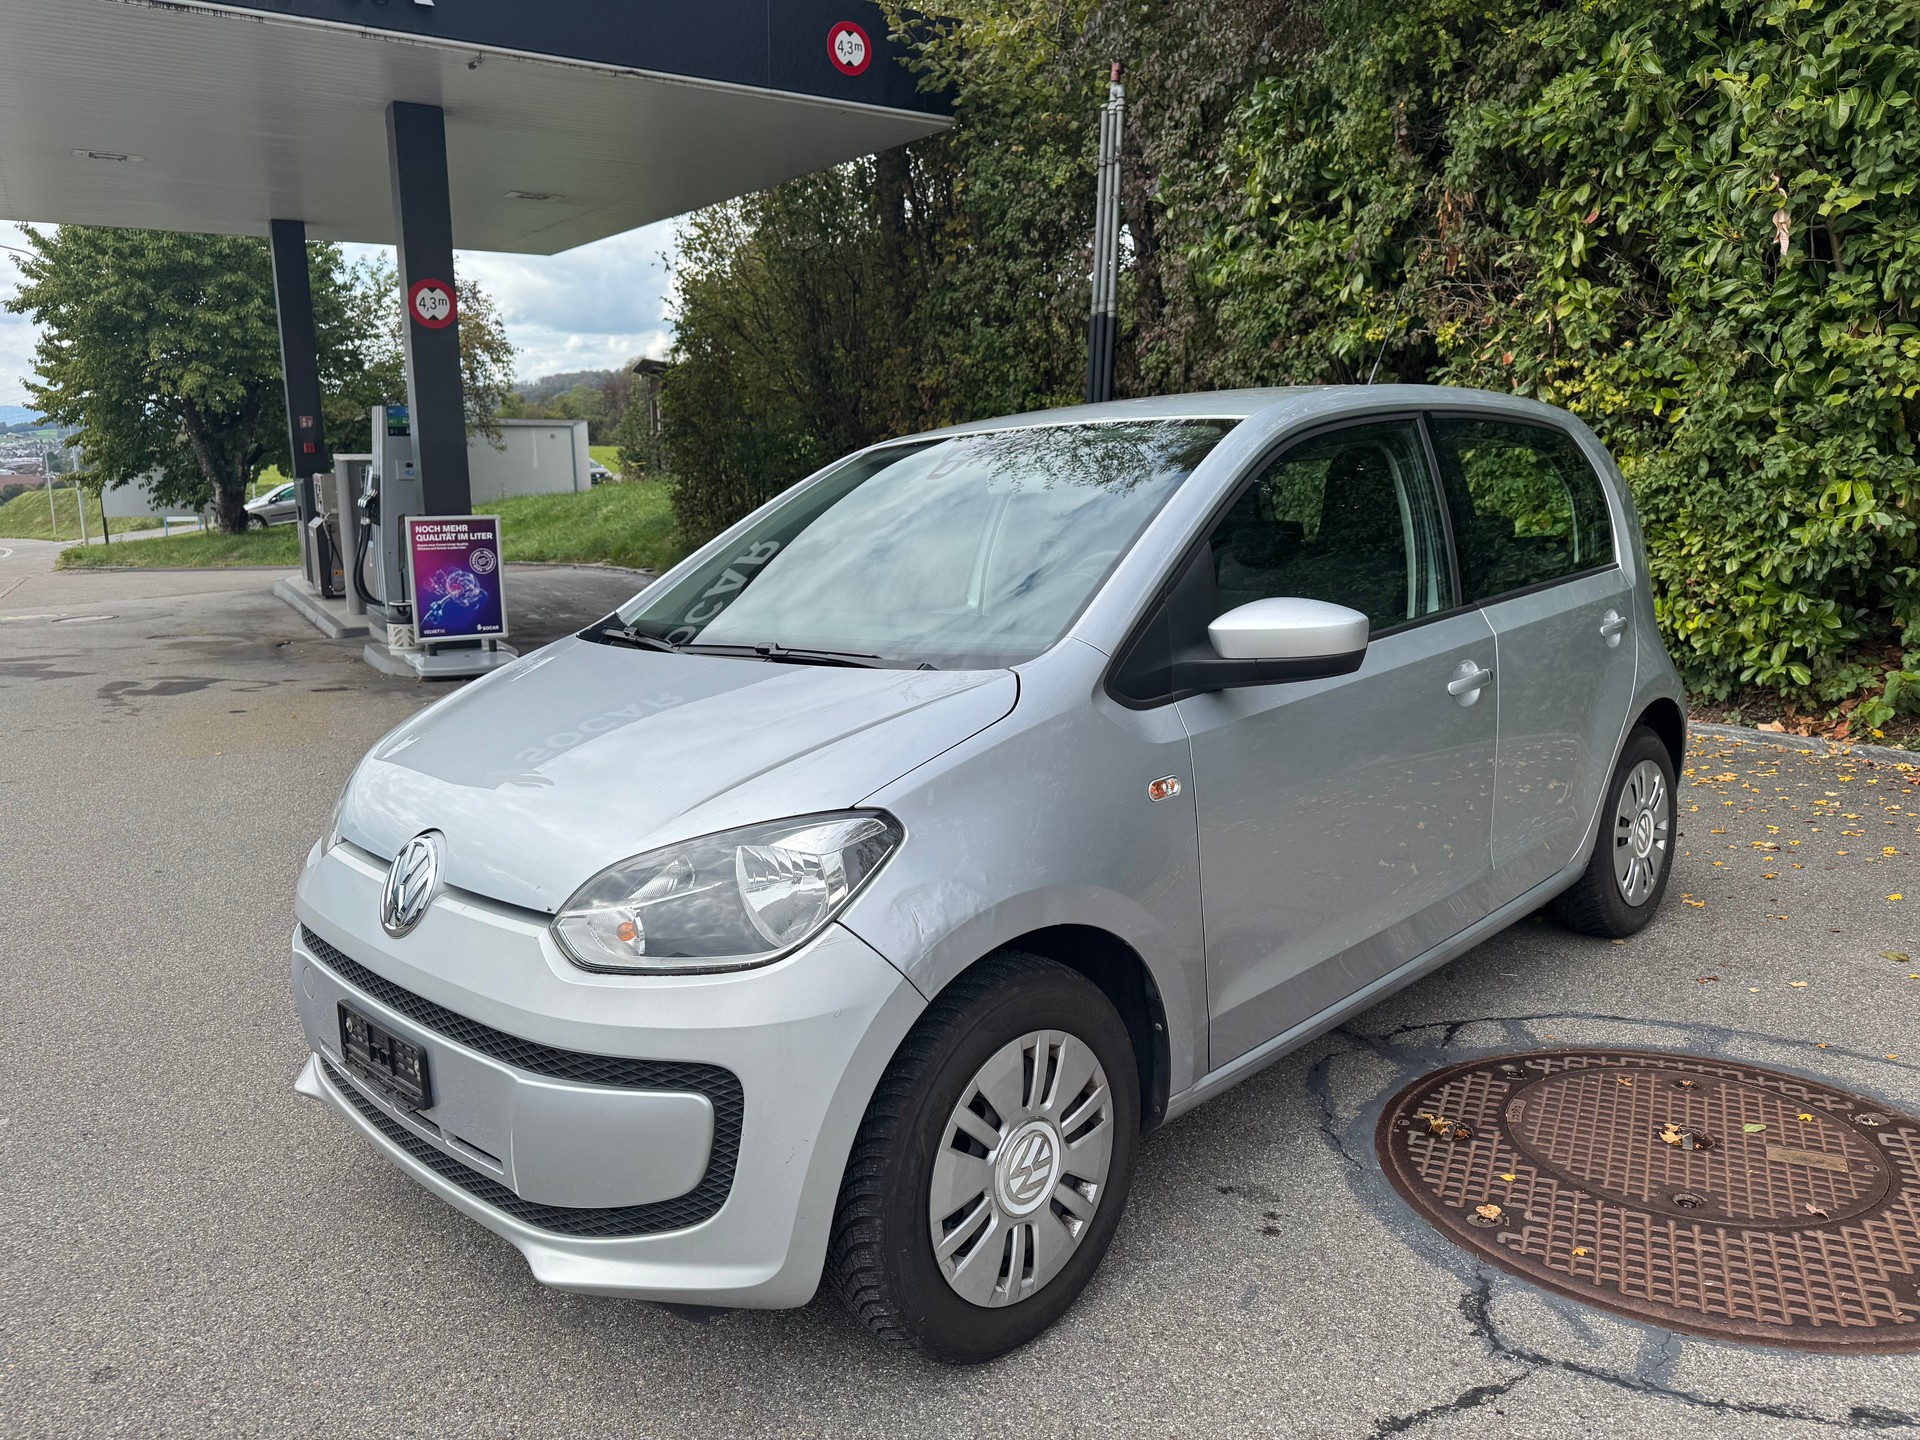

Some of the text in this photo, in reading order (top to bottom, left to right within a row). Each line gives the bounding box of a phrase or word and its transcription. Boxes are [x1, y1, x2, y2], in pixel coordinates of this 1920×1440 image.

[415, 524, 468, 533] NOCH MEHR
[416, 532, 493, 542] QUALITÄT IM LITER
